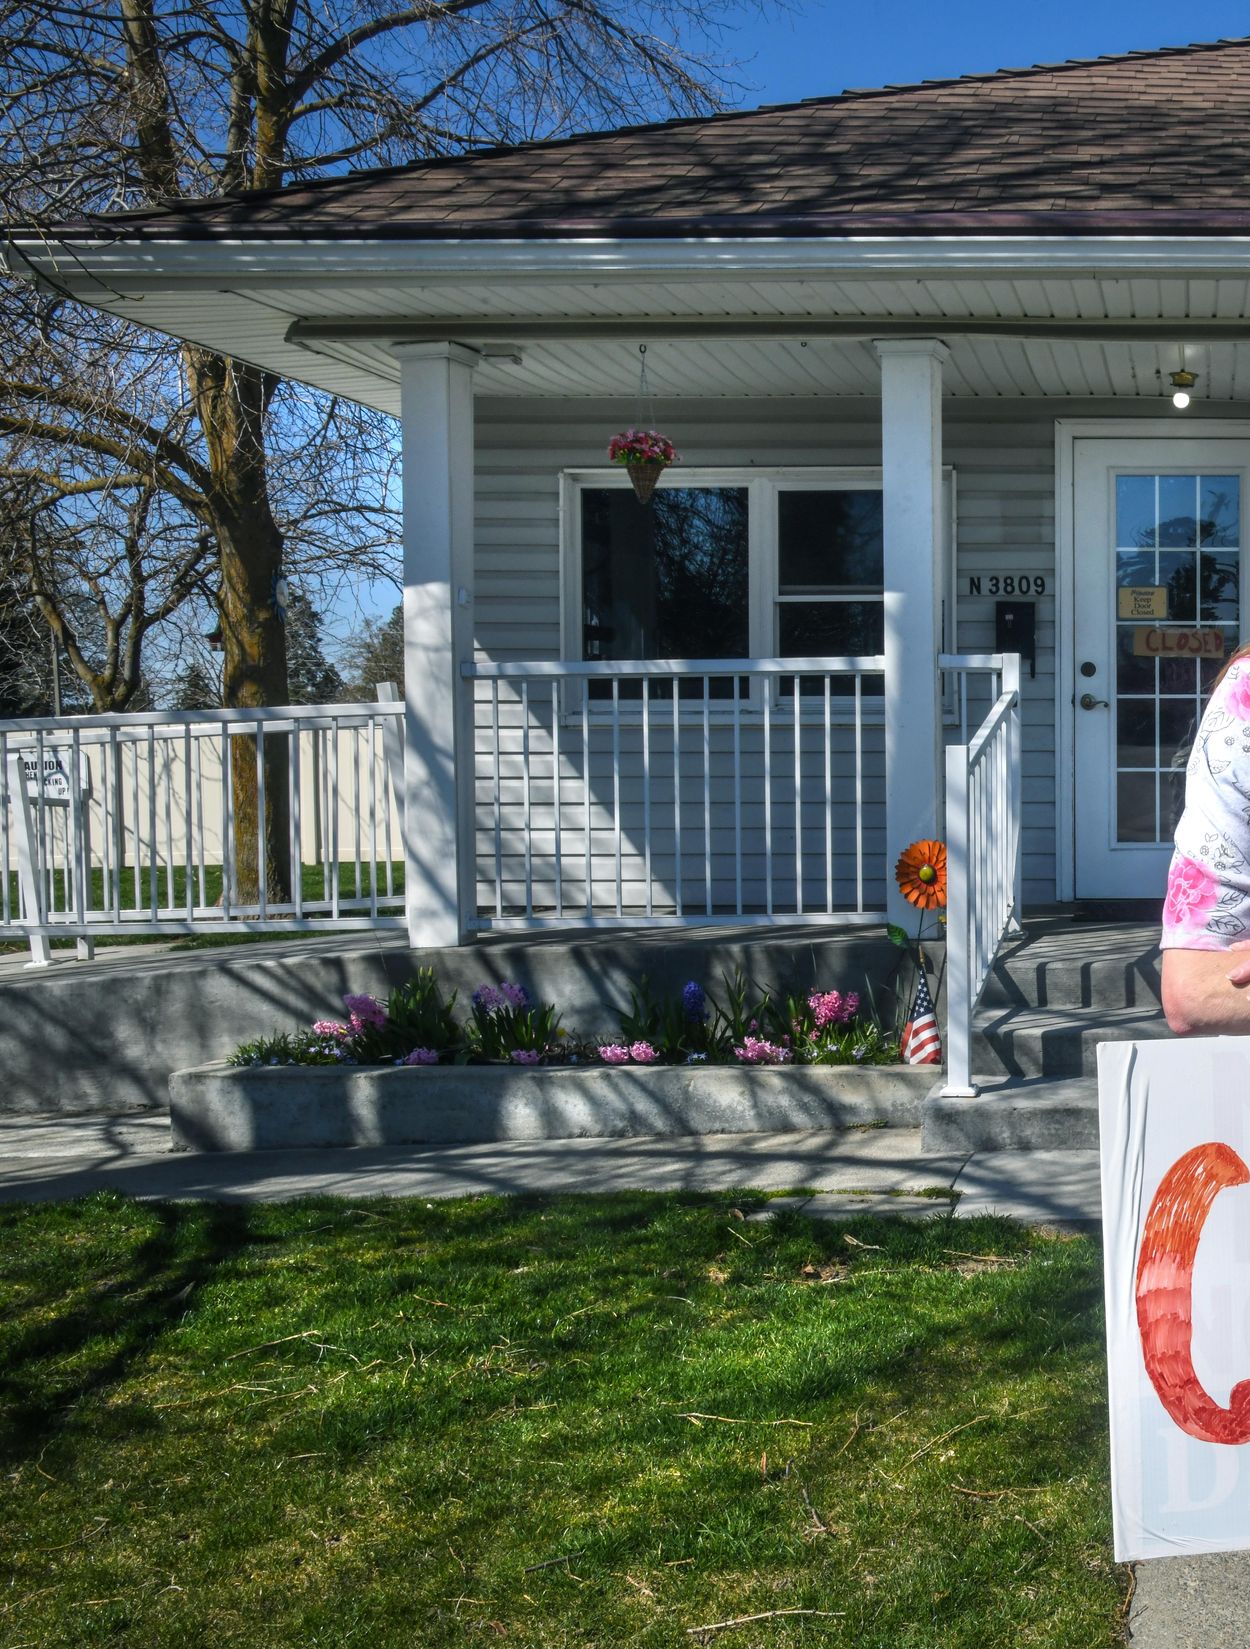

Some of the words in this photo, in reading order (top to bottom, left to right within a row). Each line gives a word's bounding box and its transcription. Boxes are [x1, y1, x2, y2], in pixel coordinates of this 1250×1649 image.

[969, 576, 981, 595] N
[988, 576, 1046, 596] 3809
[1145, 628, 1224, 654] CLOSED
